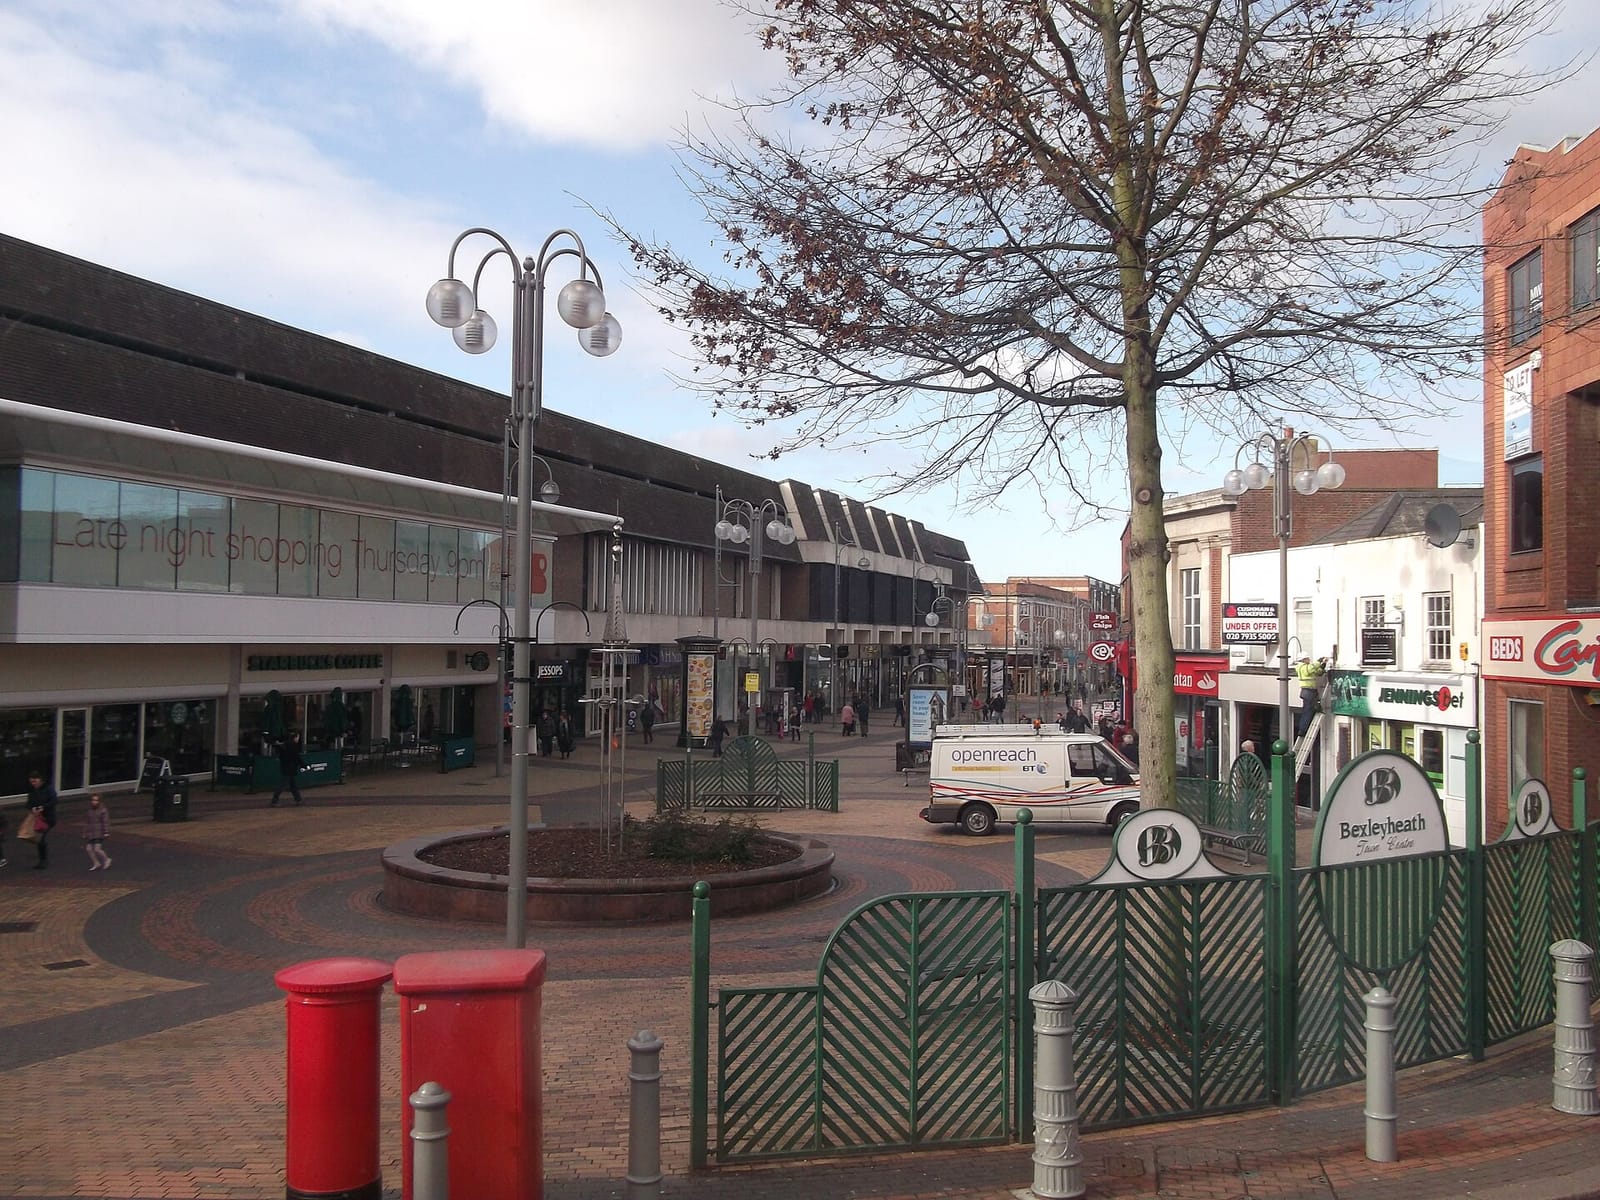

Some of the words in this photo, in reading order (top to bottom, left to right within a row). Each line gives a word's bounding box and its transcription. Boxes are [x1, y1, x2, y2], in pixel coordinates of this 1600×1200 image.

[1516, 367, 1530, 388] LET
[55, 515, 128, 551] Late
[140, 518, 216, 567] night
[225, 525, 342, 578] shopping
[351, 537, 440, 582] Thursday
[447, 549, 484, 587] 9pm
[1225, 622, 1251, 631] UNDER
[1253, 622, 1277, 631] OFFER
[1491, 638, 1521, 660] BEDS
[537, 665, 563, 678] JESSOPS
[951, 747, 1037, 764] openreach
[1339, 813, 1426, 840] Bexleyheath
